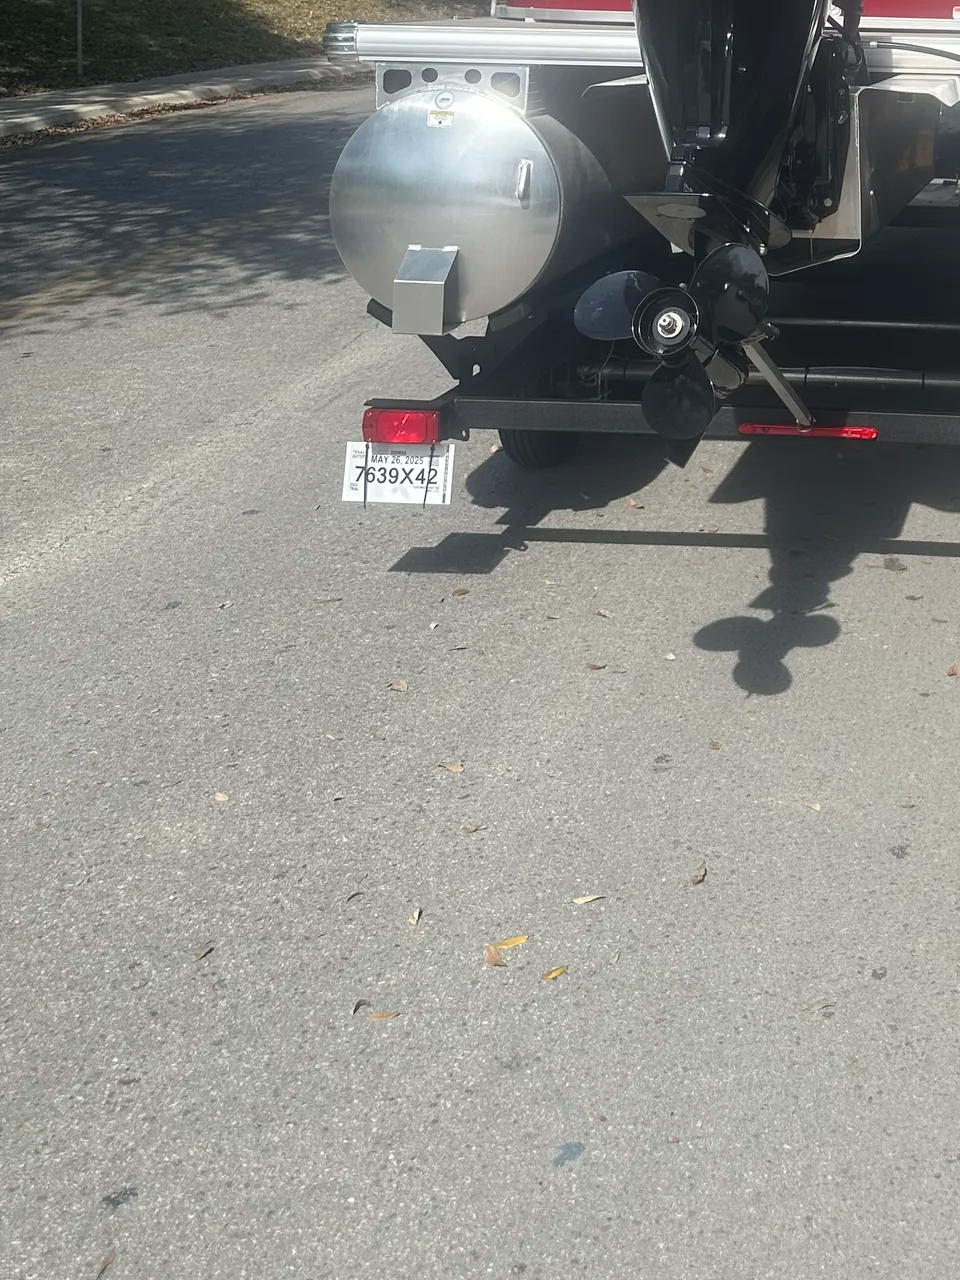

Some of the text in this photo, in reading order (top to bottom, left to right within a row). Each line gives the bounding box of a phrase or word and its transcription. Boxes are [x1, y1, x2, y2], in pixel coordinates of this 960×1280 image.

[371, 455, 389, 464] MAY
[391, 455, 403, 465] 26,
[405, 456, 424, 465] 2025
[355, 466, 438, 485] 7639X42
